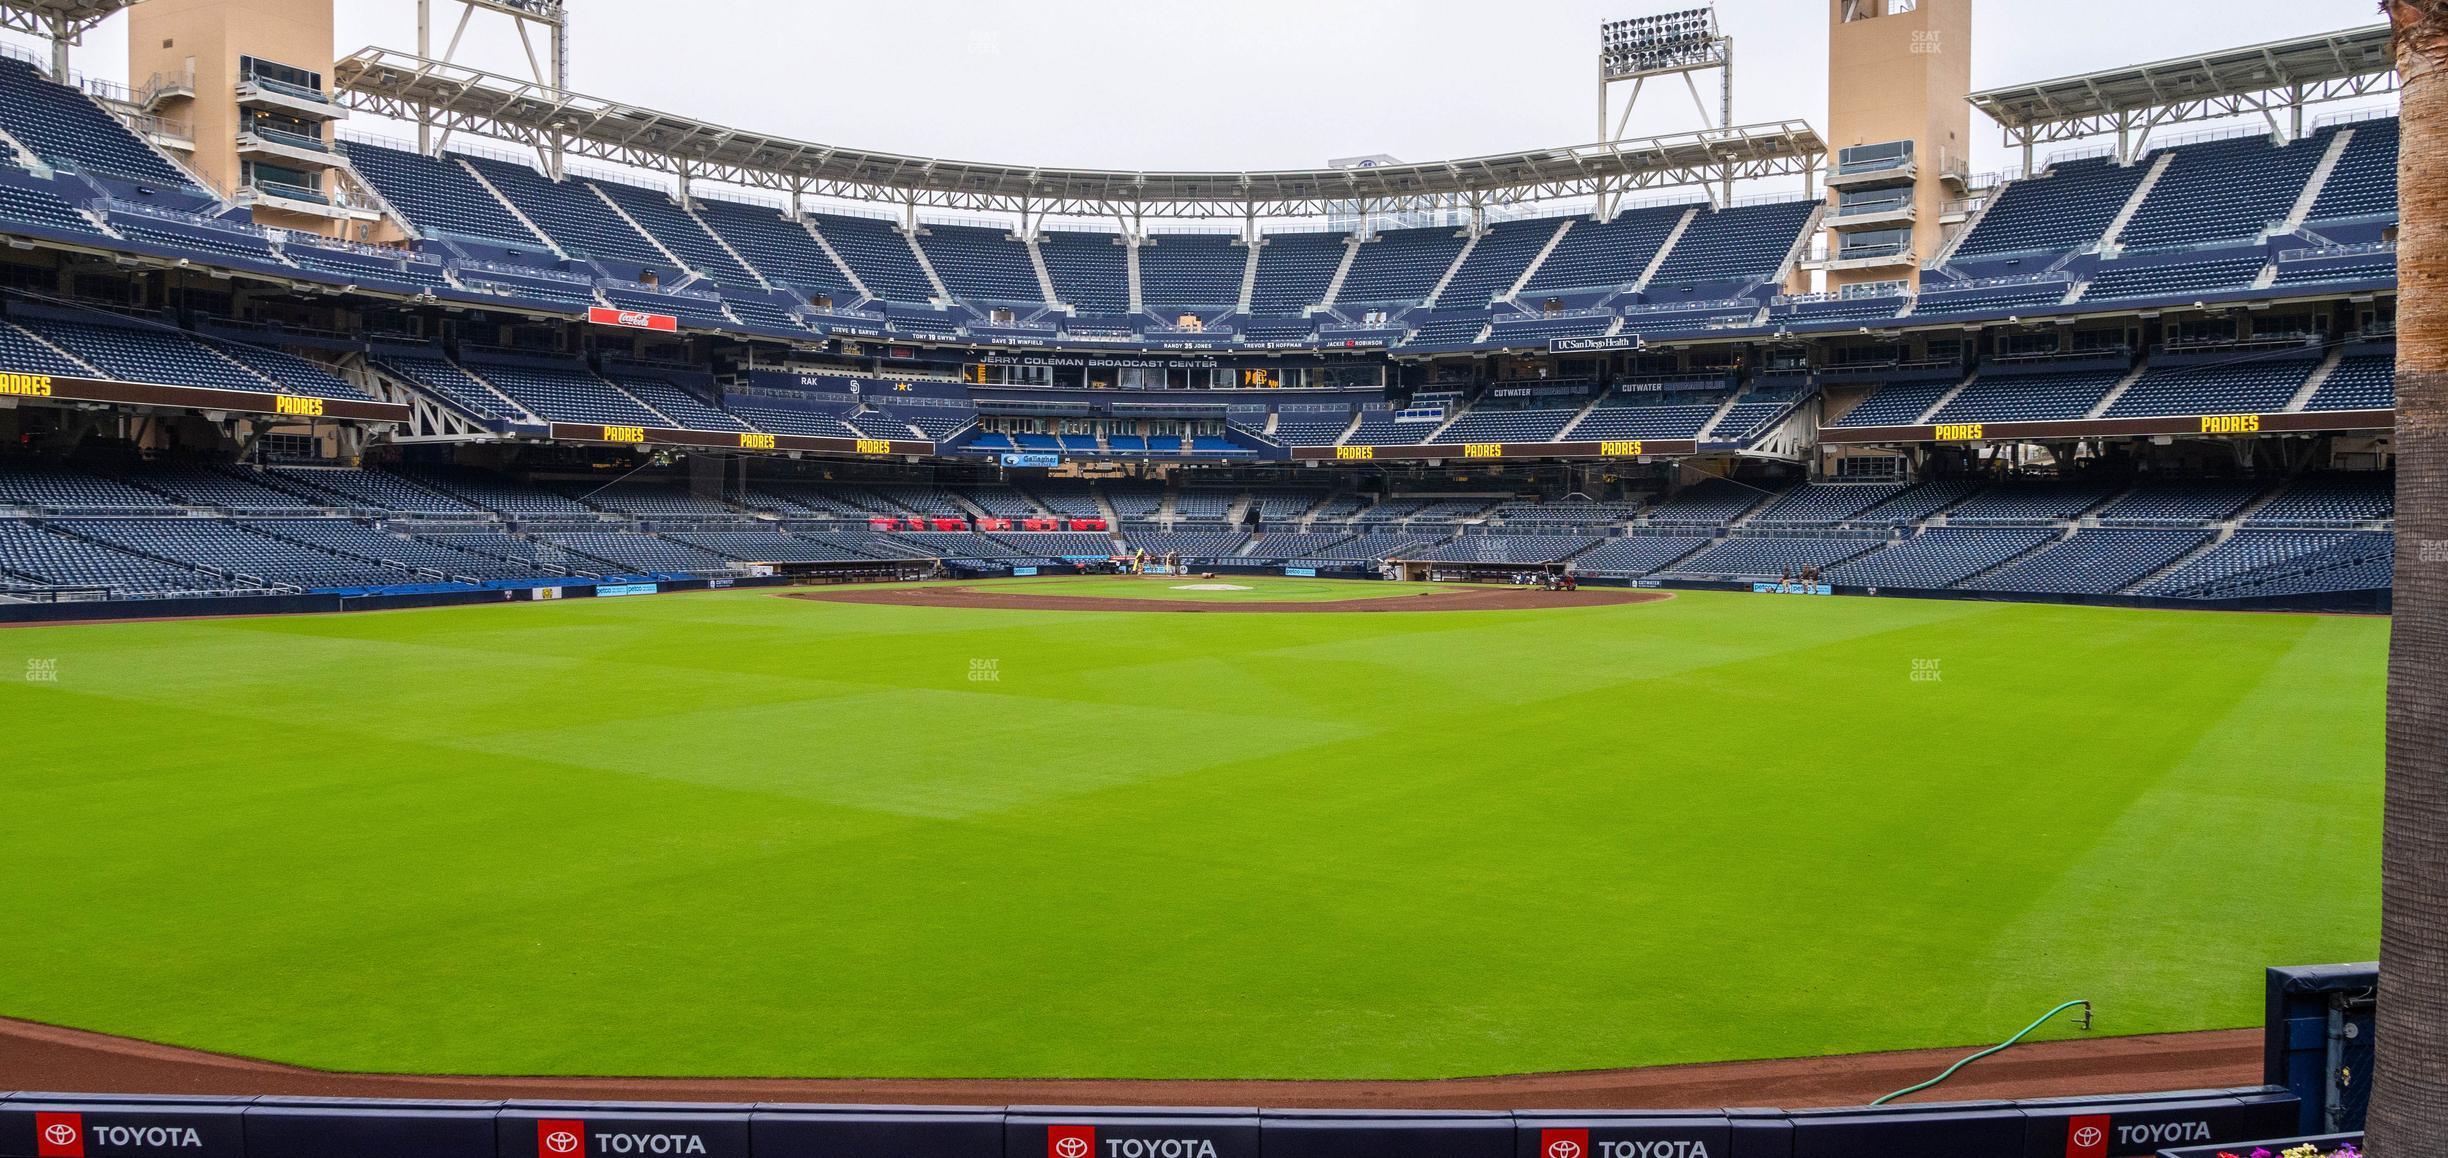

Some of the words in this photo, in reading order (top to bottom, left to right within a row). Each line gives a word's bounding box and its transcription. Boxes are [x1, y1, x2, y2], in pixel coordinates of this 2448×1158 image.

[1558, 340, 1570, 349] UC
[1570, 340, 1584, 348] San
[1584, 340, 1604, 350] Diego
[1605, 338, 1630, 347] Health
[980, 356, 1018, 364] JERRY
[1024, 358, 1083, 366] COLEMAN
[801, 377, 817, 386] RAK
[1622, 384, 1662, 392] CUTWATER
[1494, 388, 1531, 397] CUTWATER
[276, 396, 323, 416] PADRES
[2201, 415, 2259, 432] PADRES
[604, 426, 644, 442] PADRES
[1935, 424, 1982, 440] PADRES
[740, 434, 775, 448] PADRES
[856, 439, 890, 453] PADRES
[1337, 447, 1372, 459] PADRES
[1465, 444, 1501, 457] PADRES
[1601, 442, 1641, 456] PADRES
[93, 1126, 202, 1147] TOYOTA
[2118, 1121, 2211, 1144] TOYOTA
[595, 1133, 706, 1154] TOYOTA
[1106, 1139, 1217, 1158] TOYOTA
[1599, 1141, 1708, 1158] TOYOTA
